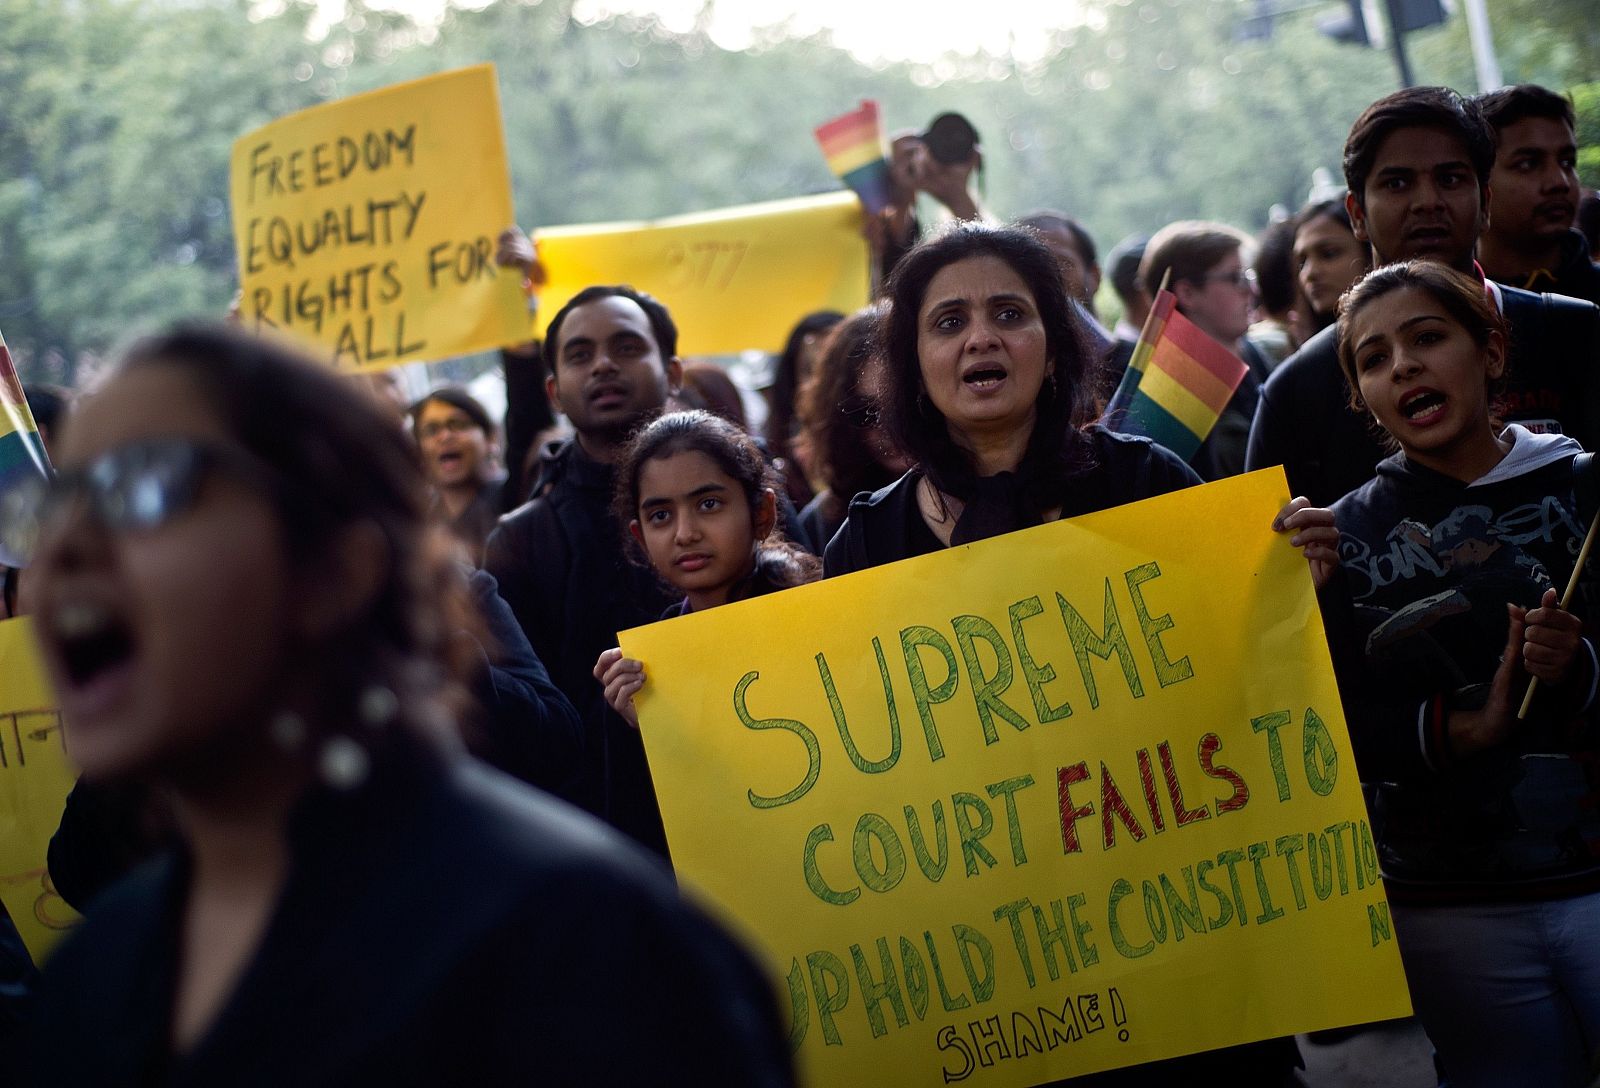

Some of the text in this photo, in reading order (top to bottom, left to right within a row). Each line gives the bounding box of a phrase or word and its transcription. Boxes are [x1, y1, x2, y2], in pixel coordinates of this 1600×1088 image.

[247, 123, 416, 203] FREEDOM
[247, 192, 426, 273] EQUALITY
[251, 234, 497, 334] RIGHTS FOR
[334, 312, 426, 365] ALL
[734, 561, 1194, 809] SUPREME
[803, 707, 1338, 906] COURT FAILS TO
[993, 892, 1100, 988] THE
[1367, 901, 1391, 947] N
